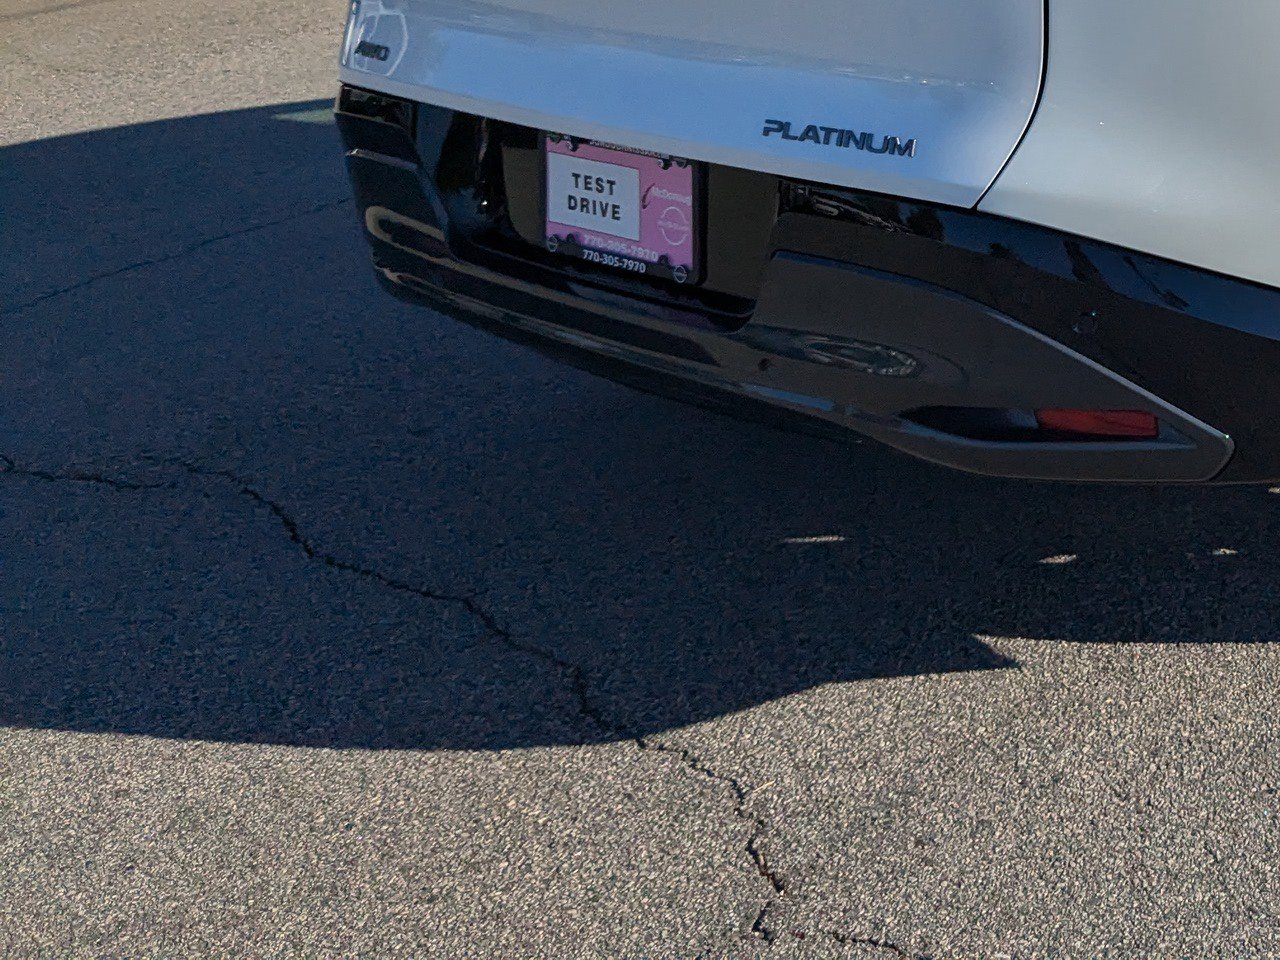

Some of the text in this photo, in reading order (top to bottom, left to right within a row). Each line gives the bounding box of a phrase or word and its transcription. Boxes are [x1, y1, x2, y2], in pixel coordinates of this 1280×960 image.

[762, 119, 917, 158] PLATINUM
[572, 172, 616, 196] TEST
[568, 194, 621, 221] DRIVE
[582, 249, 646, 274] 770-305-7970
